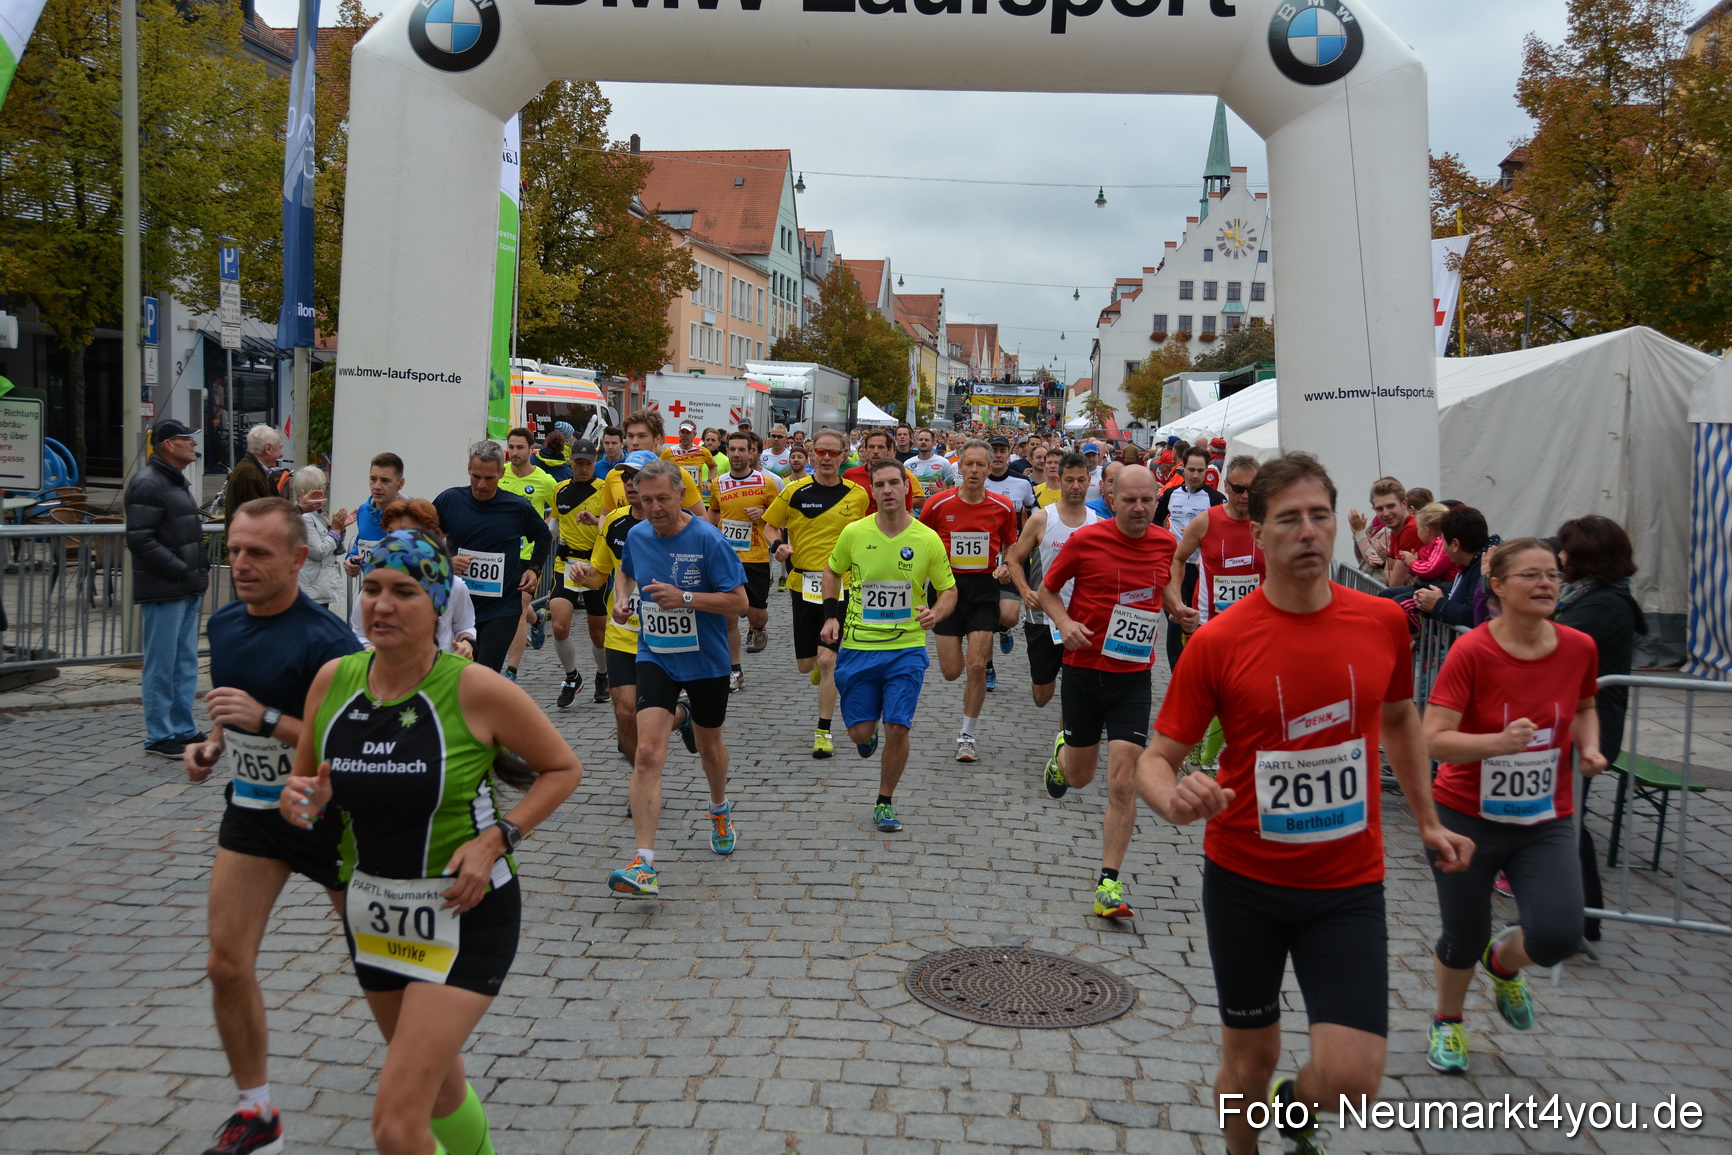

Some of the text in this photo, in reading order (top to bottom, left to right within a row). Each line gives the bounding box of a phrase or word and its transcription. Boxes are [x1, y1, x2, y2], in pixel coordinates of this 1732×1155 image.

[338, 366, 462, 384] www.bmw-laufsport.de
[1304, 385, 1434, 402] www.bmw-laufsport.de
[689, 400, 721, 409] Bayerisches
[4, 408, 39, 420] Richtung
[10, 431, 29, 440] über
[720, 489, 766, 503] MAX BÖGL
[723, 526, 750, 540] 2767
[956, 541, 981, 555] 515
[461, 562, 499, 581] 680
[470, 582, 485, 590] Tom
[867, 591, 906, 608] 2671
[1129, 592, 1145, 600] DEHN
[880, 611, 894, 619] Ralf
[1114, 608, 1133, 619] PARTL
[647, 614, 692, 635] 3059
[1113, 618, 1156, 643] 2554
[1304, 711, 1333, 728] DEHN
[362, 741, 397, 755] DAV
[232, 748, 292, 782] 2654
[331, 757, 427, 774] Röthenbach
[1258, 754, 1348, 770] PARTL Neumarkt
[1484, 757, 1550, 768] PARTL Neumarkt
[1268, 765, 1358, 810] 2610
[1490, 767, 1552, 797] 2039
[1286, 811, 1345, 831] Berthold
[352, 879, 439, 900] PARTL Neumarkt
[368, 900, 436, 941] 370
[387, 941, 427, 962] Ulrike
